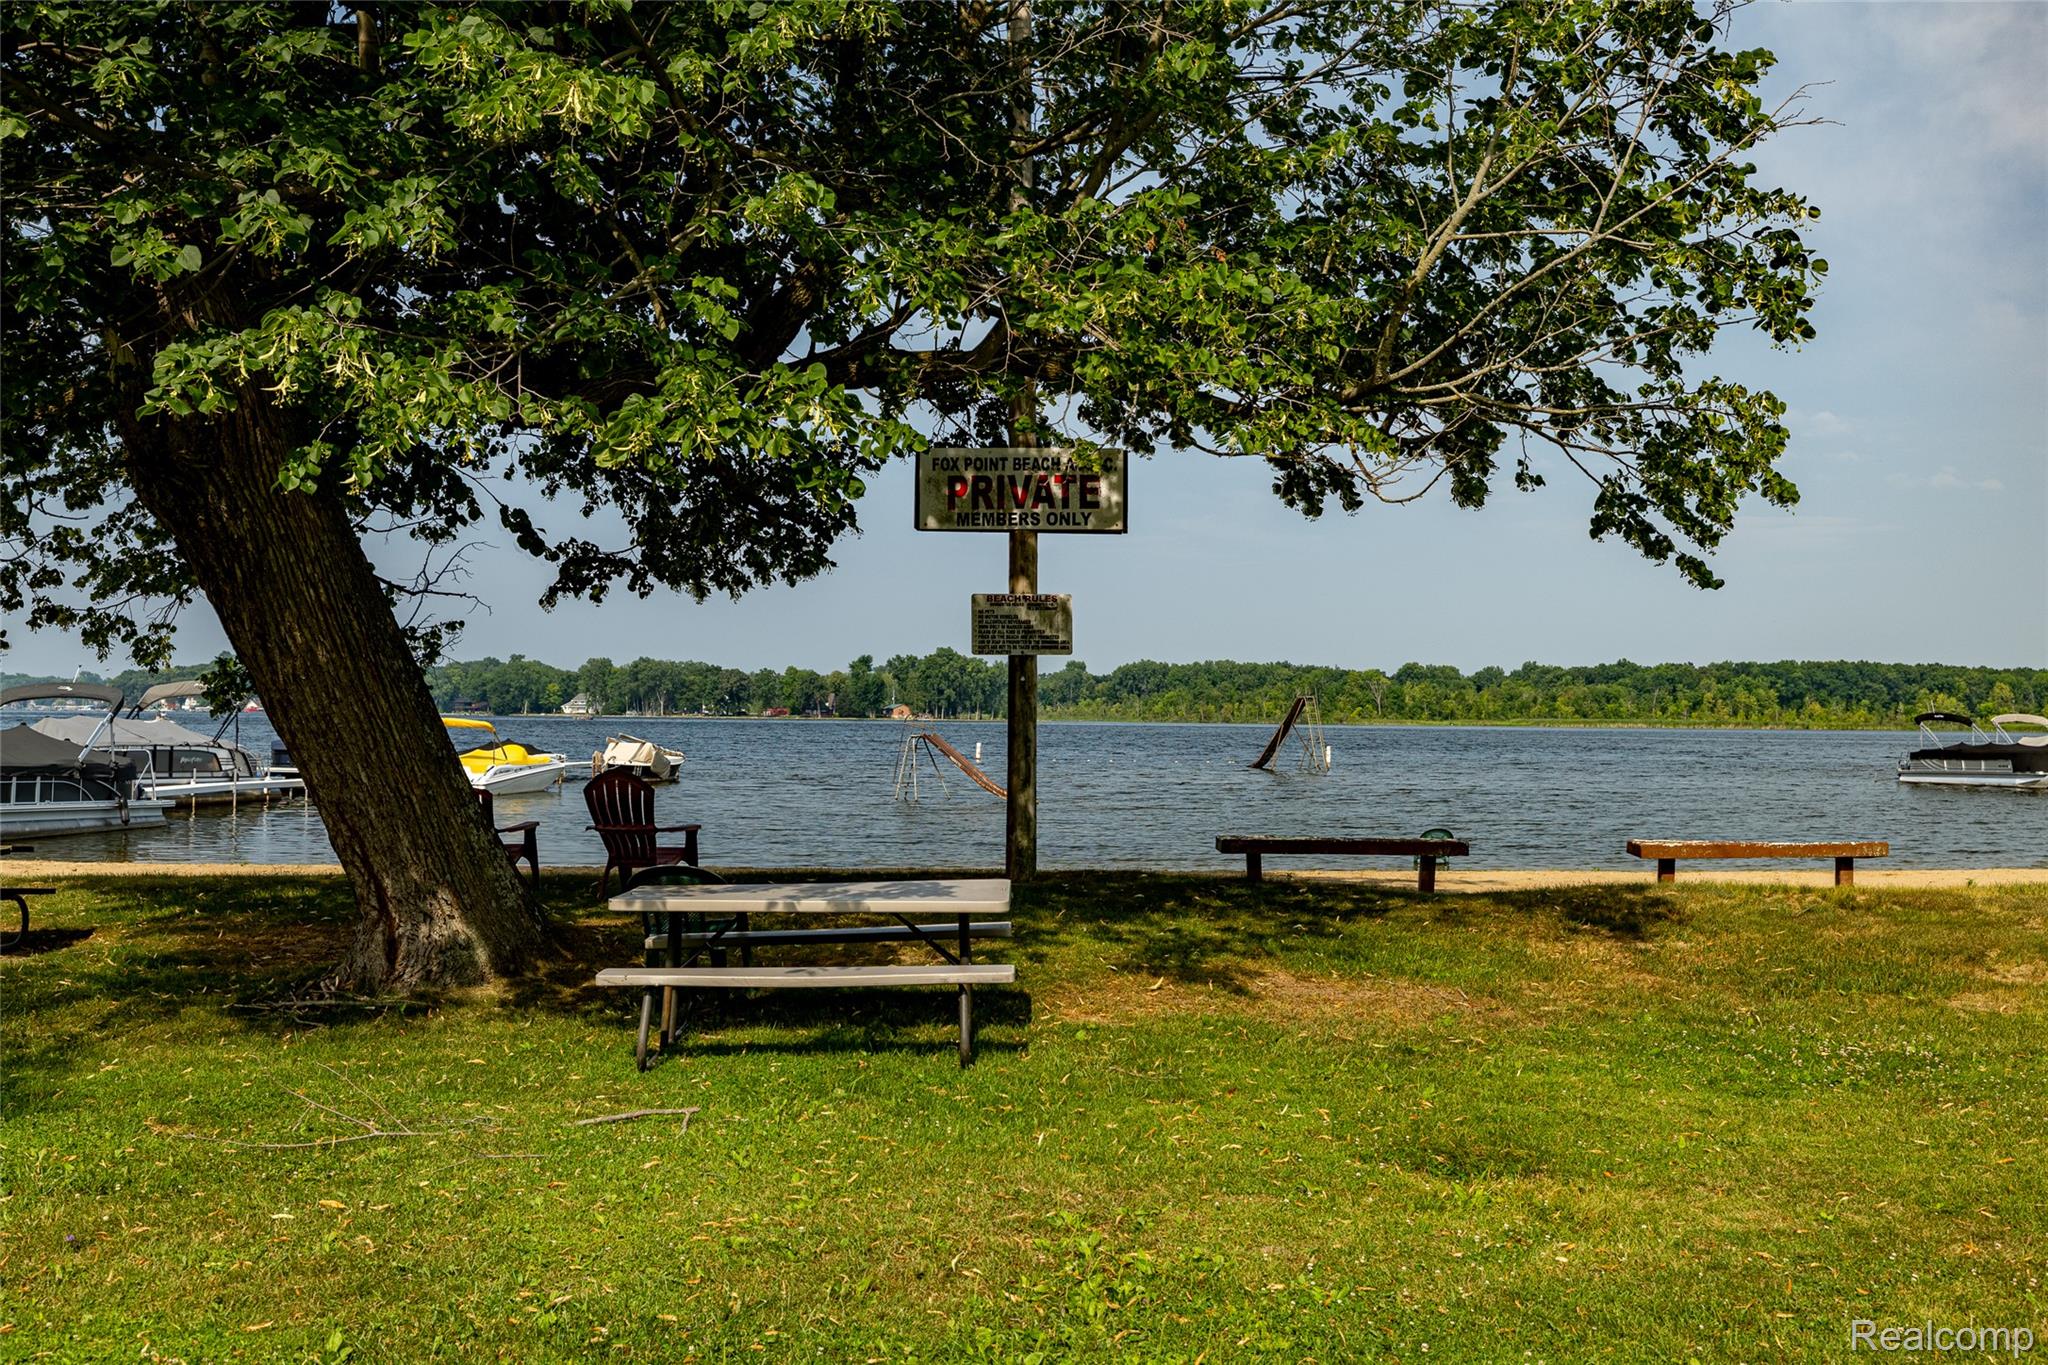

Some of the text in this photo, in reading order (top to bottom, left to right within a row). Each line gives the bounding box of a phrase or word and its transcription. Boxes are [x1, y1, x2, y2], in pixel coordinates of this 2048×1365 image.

[932, 457, 960, 471] FOX
[964, 457, 1008, 471] POINT
[1013, 457, 1060, 471] BEACH
[947, 474, 1100, 510] PRIVATE
[956, 512, 1092, 526] MEMBERS ONLY
